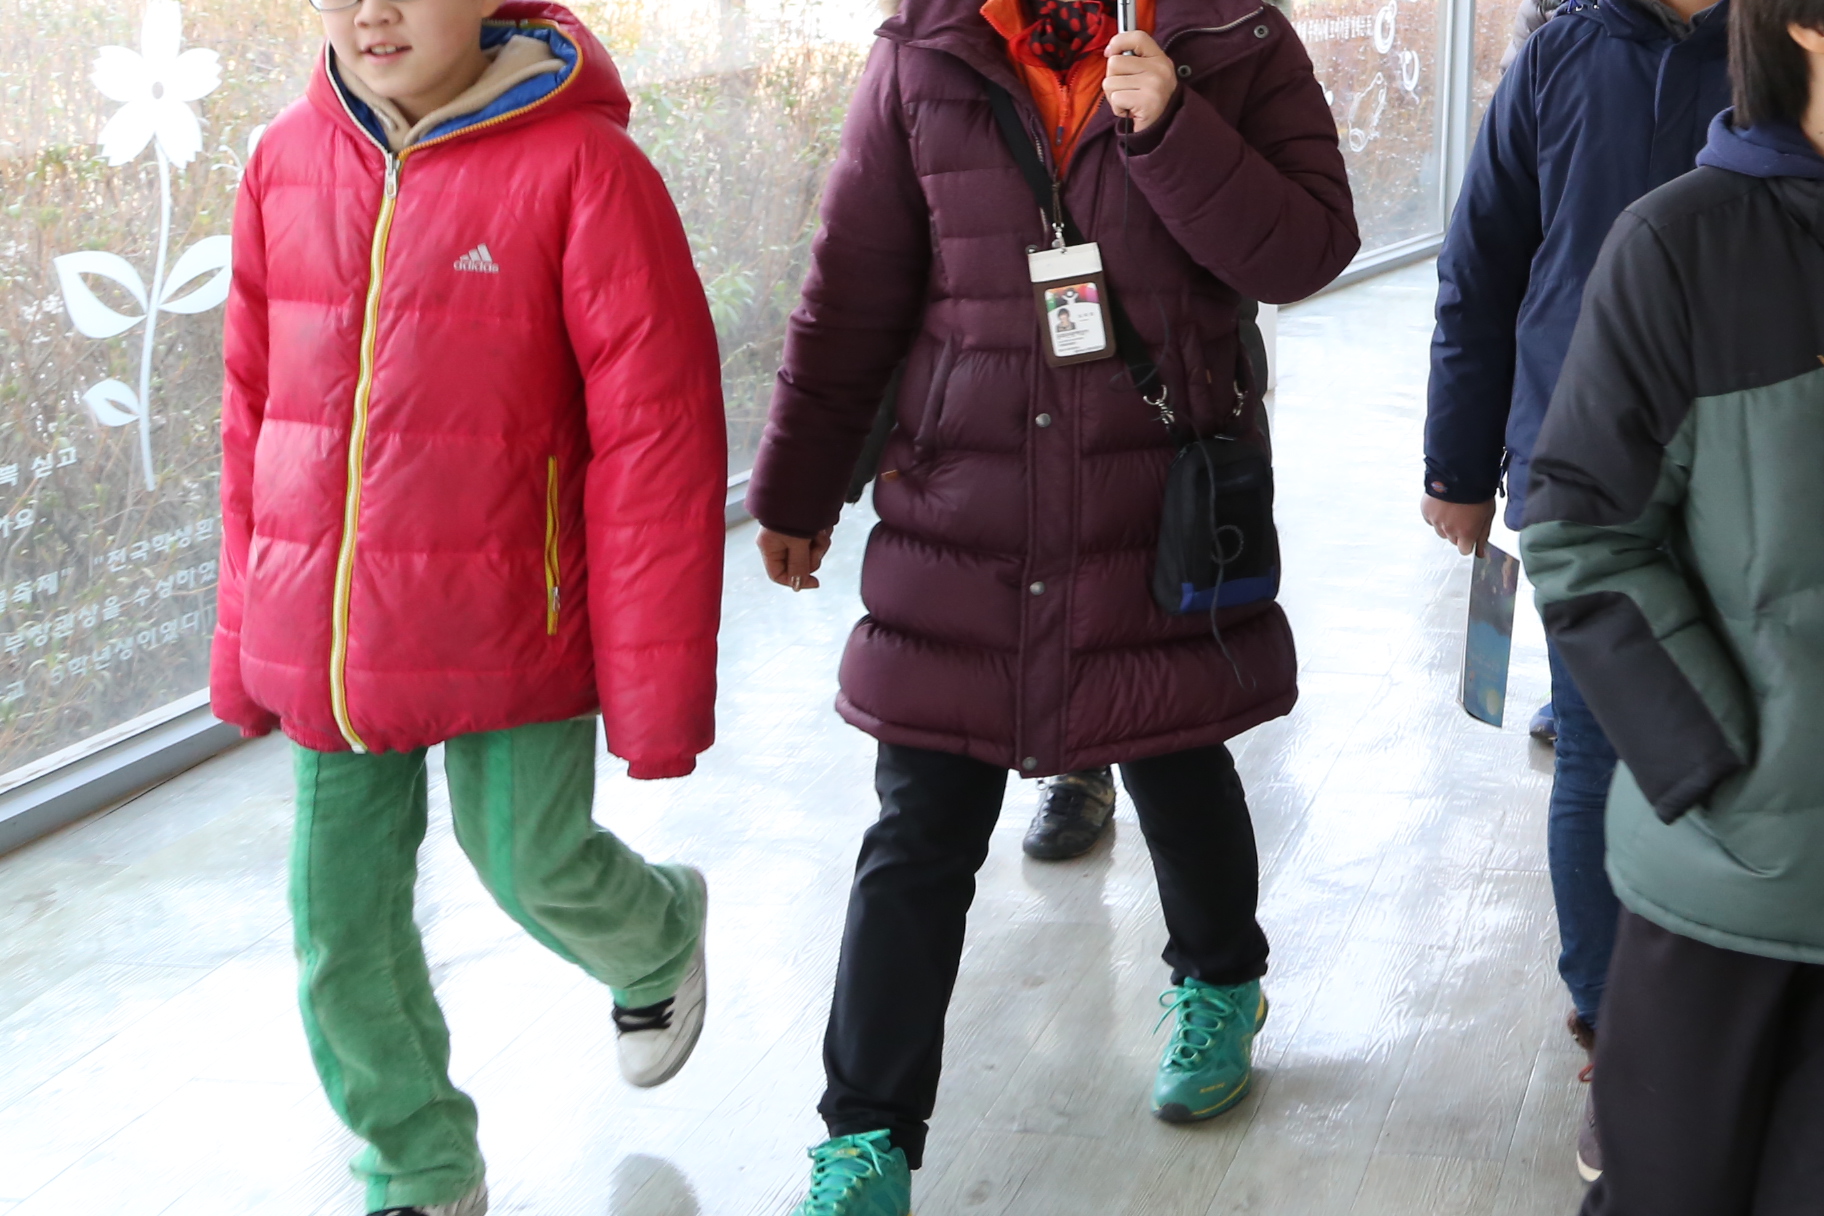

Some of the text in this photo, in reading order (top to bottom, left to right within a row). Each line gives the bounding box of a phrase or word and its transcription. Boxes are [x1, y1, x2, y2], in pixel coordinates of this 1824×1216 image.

[453, 259, 499, 273] adidas
[30, 446, 77, 478] 싣고
[0, 514, 221, 613] 축제" "전국학생환
[4, 595, 121, 656] 부장관상을
